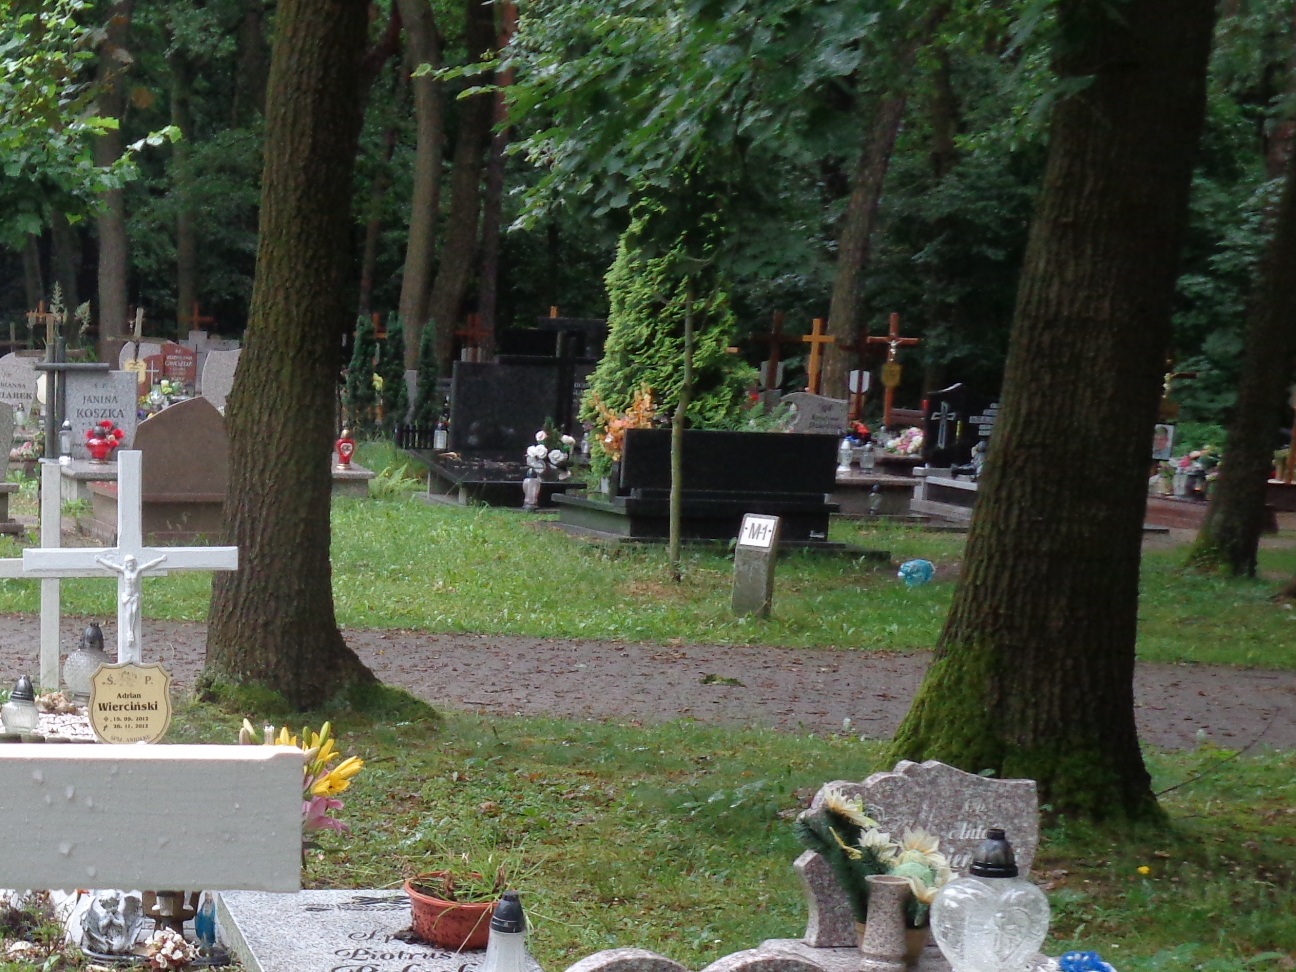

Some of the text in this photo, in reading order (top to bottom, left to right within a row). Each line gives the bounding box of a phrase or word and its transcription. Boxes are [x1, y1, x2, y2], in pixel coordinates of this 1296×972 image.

[83, 395, 119, 405] JANINA
[75, 408, 125, 419] KOSZKA
[98, 700, 158, 712] Wierciński
